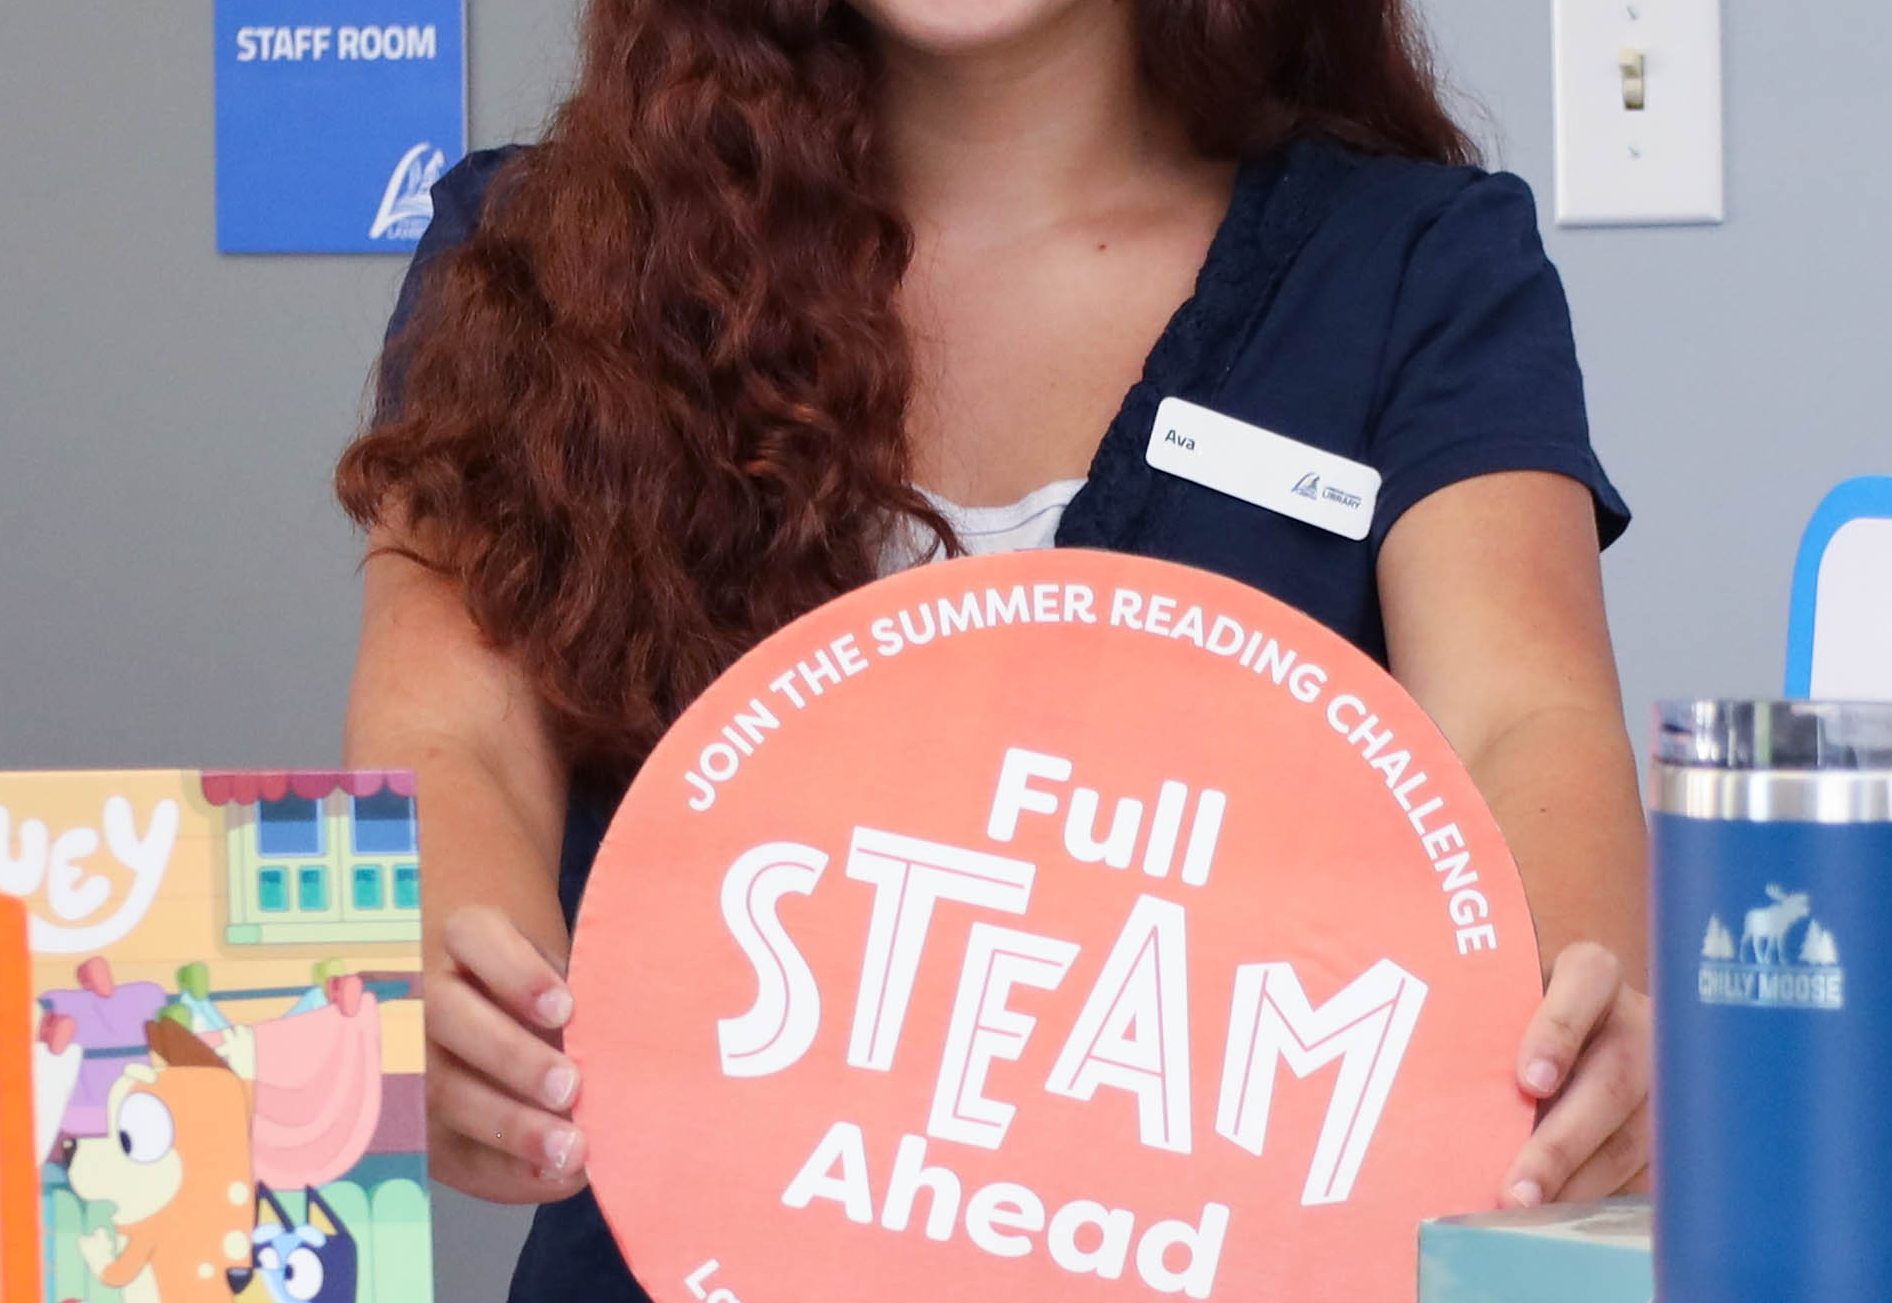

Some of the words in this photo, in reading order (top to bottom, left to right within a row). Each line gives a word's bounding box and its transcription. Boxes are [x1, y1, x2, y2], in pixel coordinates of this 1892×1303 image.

[236, 26, 332, 62] STAFF
[337, 24, 438, 61] ROOM
[1164, 429, 1196, 451] Ava
[685, 706, 781, 814] JOIN
[768, 635, 869, 709] THE
[871, 581, 1098, 659] SUMMER
[1108, 588, 1329, 705] READING
[1325, 691, 1498, 958] CHALLENGE
[986, 746, 1227, 888] Full
[716, 824, 1429, 1207] STEAM
[1757, 968, 1843, 1009] MOOSE
[779, 1120, 1231, 1301] Ahead
